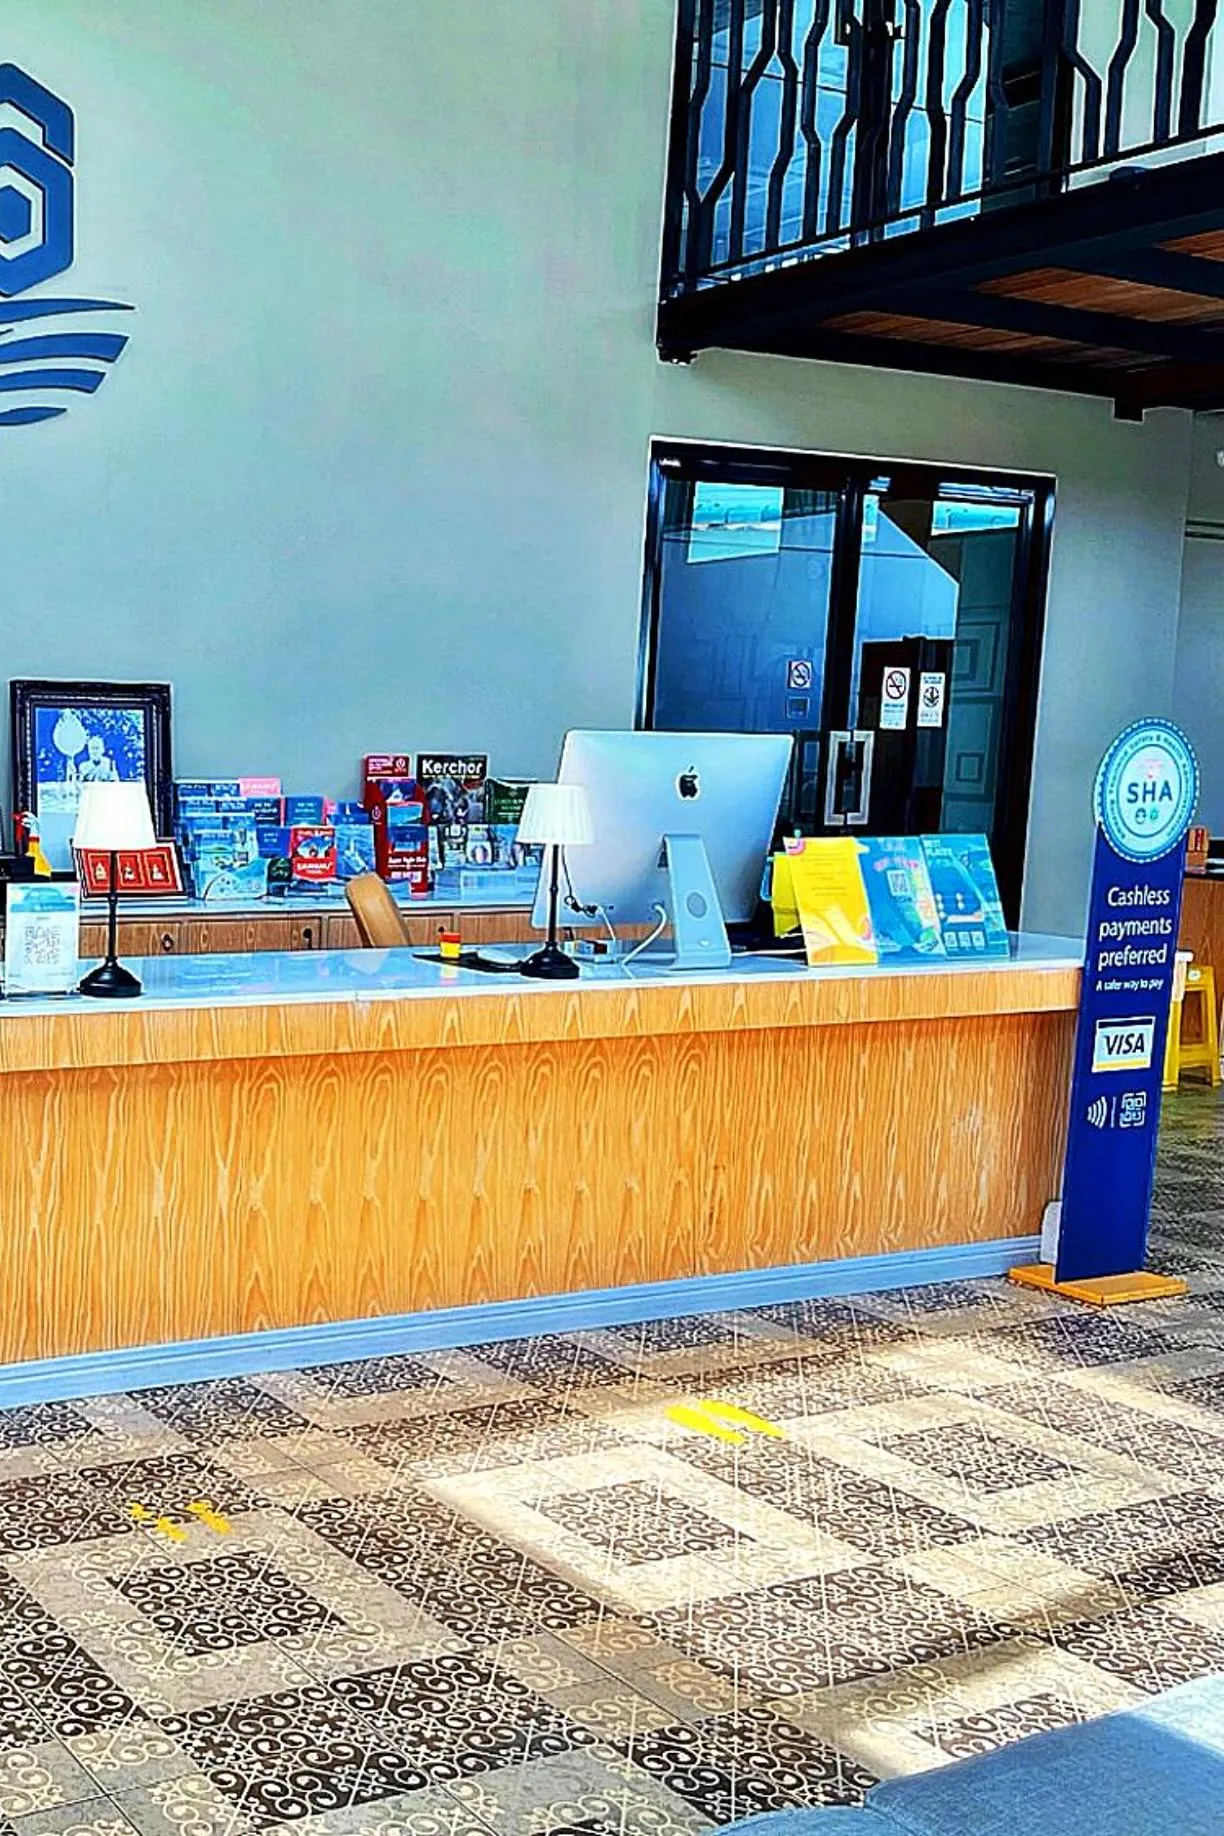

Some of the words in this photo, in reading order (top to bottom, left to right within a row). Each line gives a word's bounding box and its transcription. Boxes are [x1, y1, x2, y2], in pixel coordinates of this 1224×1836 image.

[422, 759, 483, 774] Kerchor
[1127, 781, 1173, 803] SHA
[1107, 884, 1171, 907] Cashless
[1098, 917, 1173, 942] payments
[1098, 943, 1168, 972] preferred
[1096, 980, 1103, 992] A
[1104, 979, 1123, 991] safer
[1124, 980, 1140, 992] way
[1140, 978, 1149, 989] to
[1149, 979, 1165, 991] pay
[1103, 1032, 1146, 1057] VISA
